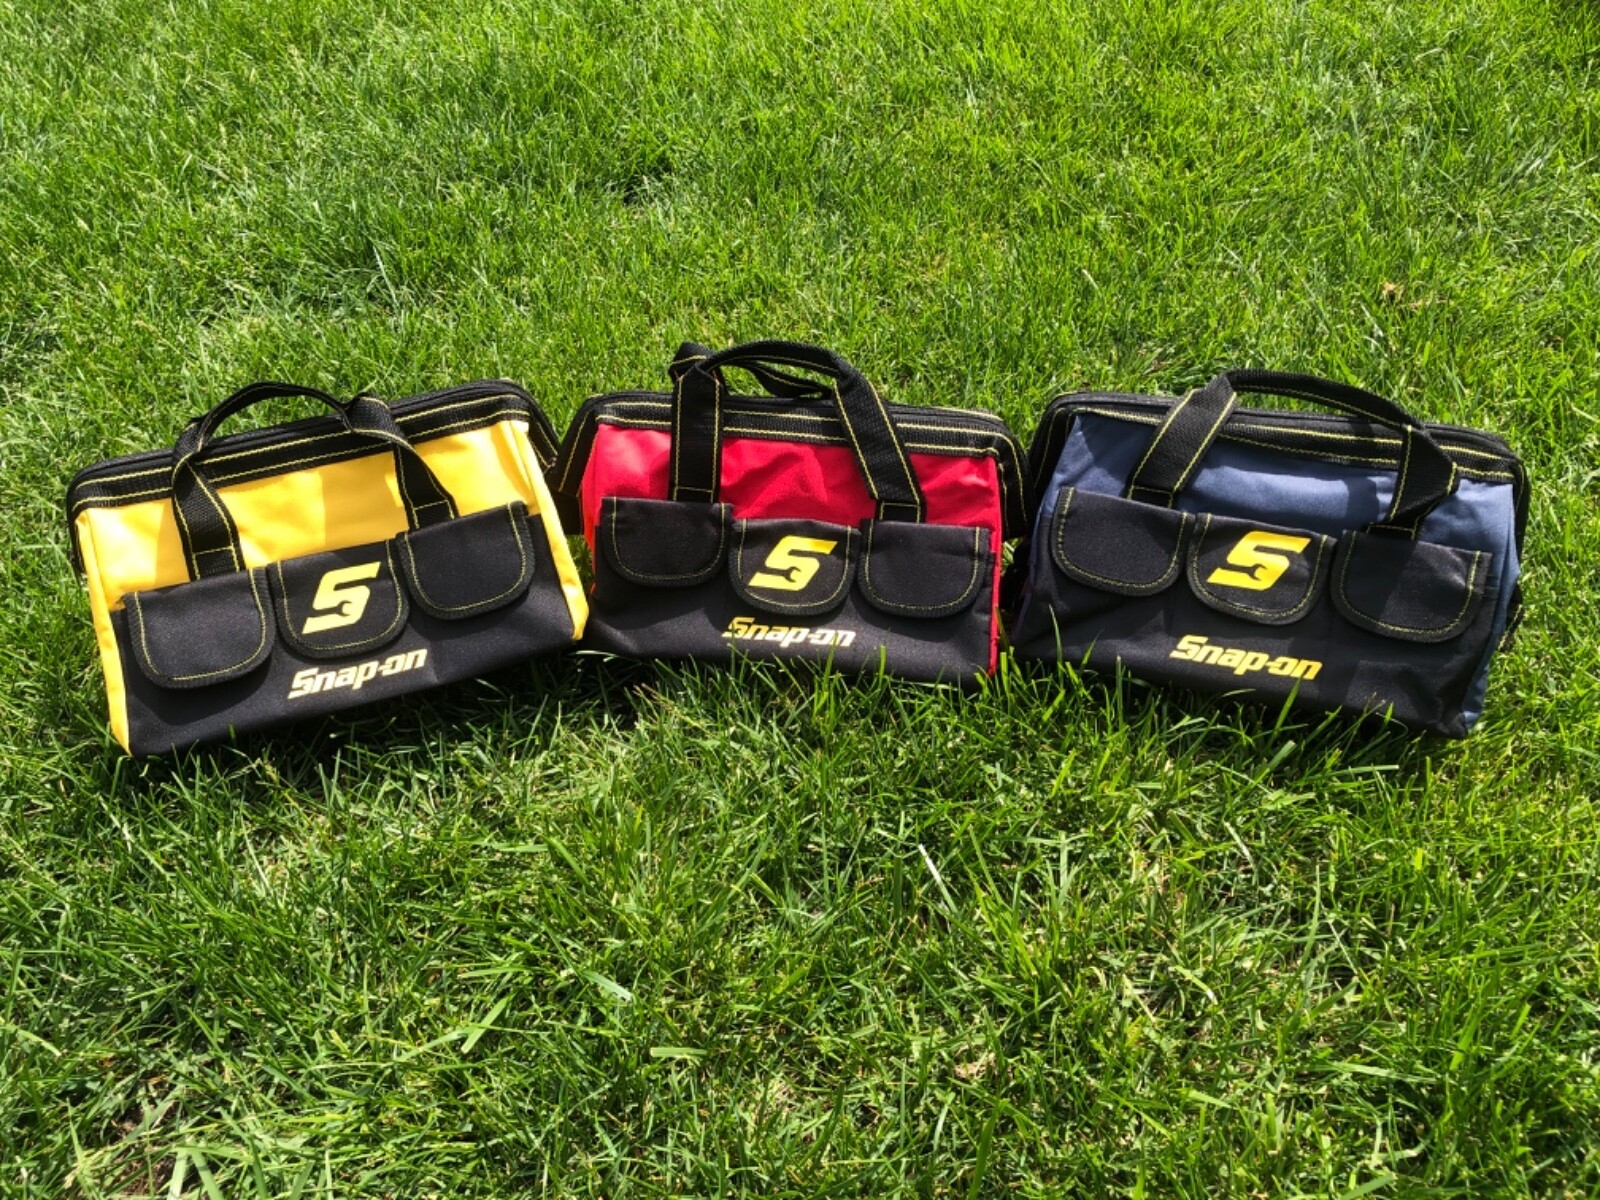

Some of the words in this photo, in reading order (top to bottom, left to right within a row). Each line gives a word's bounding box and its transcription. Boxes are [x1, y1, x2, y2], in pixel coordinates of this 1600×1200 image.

[748, 535, 838, 591] S
[1206, 530, 1311, 590] S
[302, 561, 381, 634] S
[722, 616, 857, 648] Snap-on
[1169, 634, 1323, 680] Snap-on
[287, 648, 428, 699] Snap-on
